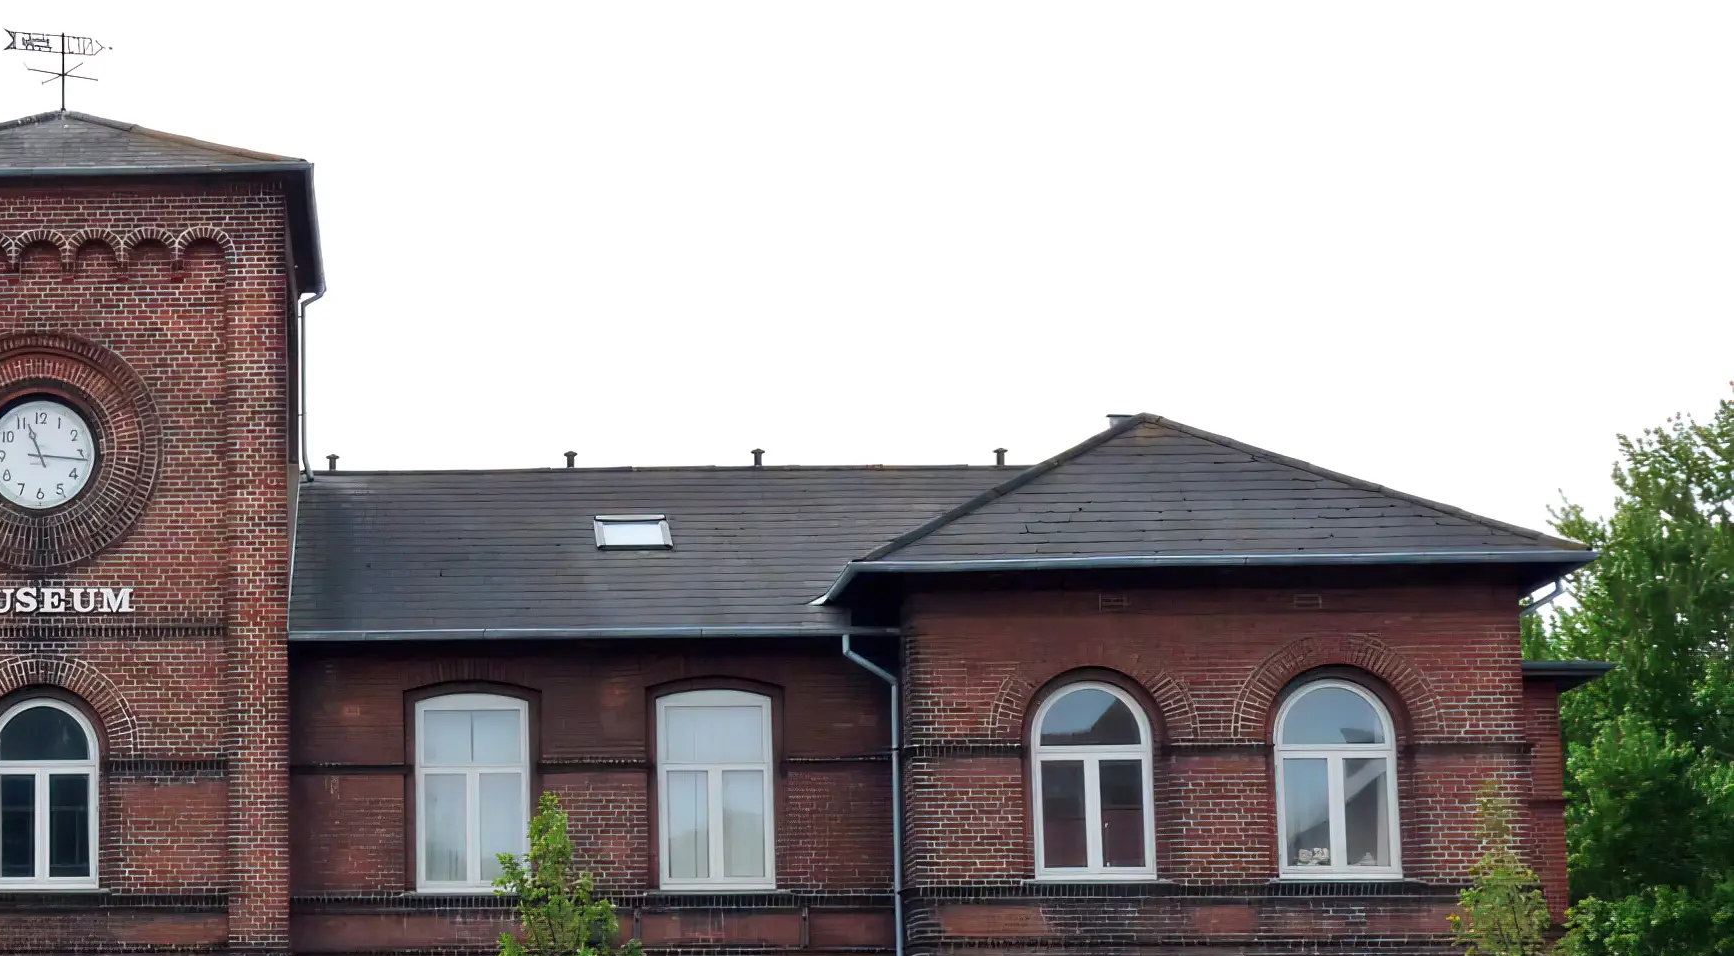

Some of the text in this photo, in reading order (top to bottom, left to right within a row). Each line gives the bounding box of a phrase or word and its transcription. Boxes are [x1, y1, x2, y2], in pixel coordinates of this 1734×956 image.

[17, 416, 26, 429] 11
[35, 412, 48, 425] 12
[2, 430, 15, 443] 10
[70, 429, 78, 442] 2
[2, 468, 12, 481] 8
[68, 467, 79, 480] 4
[17, 482, 26, 496] 7
[36, 487, 45, 500] 6
[56, 482, 65, 497] 5
